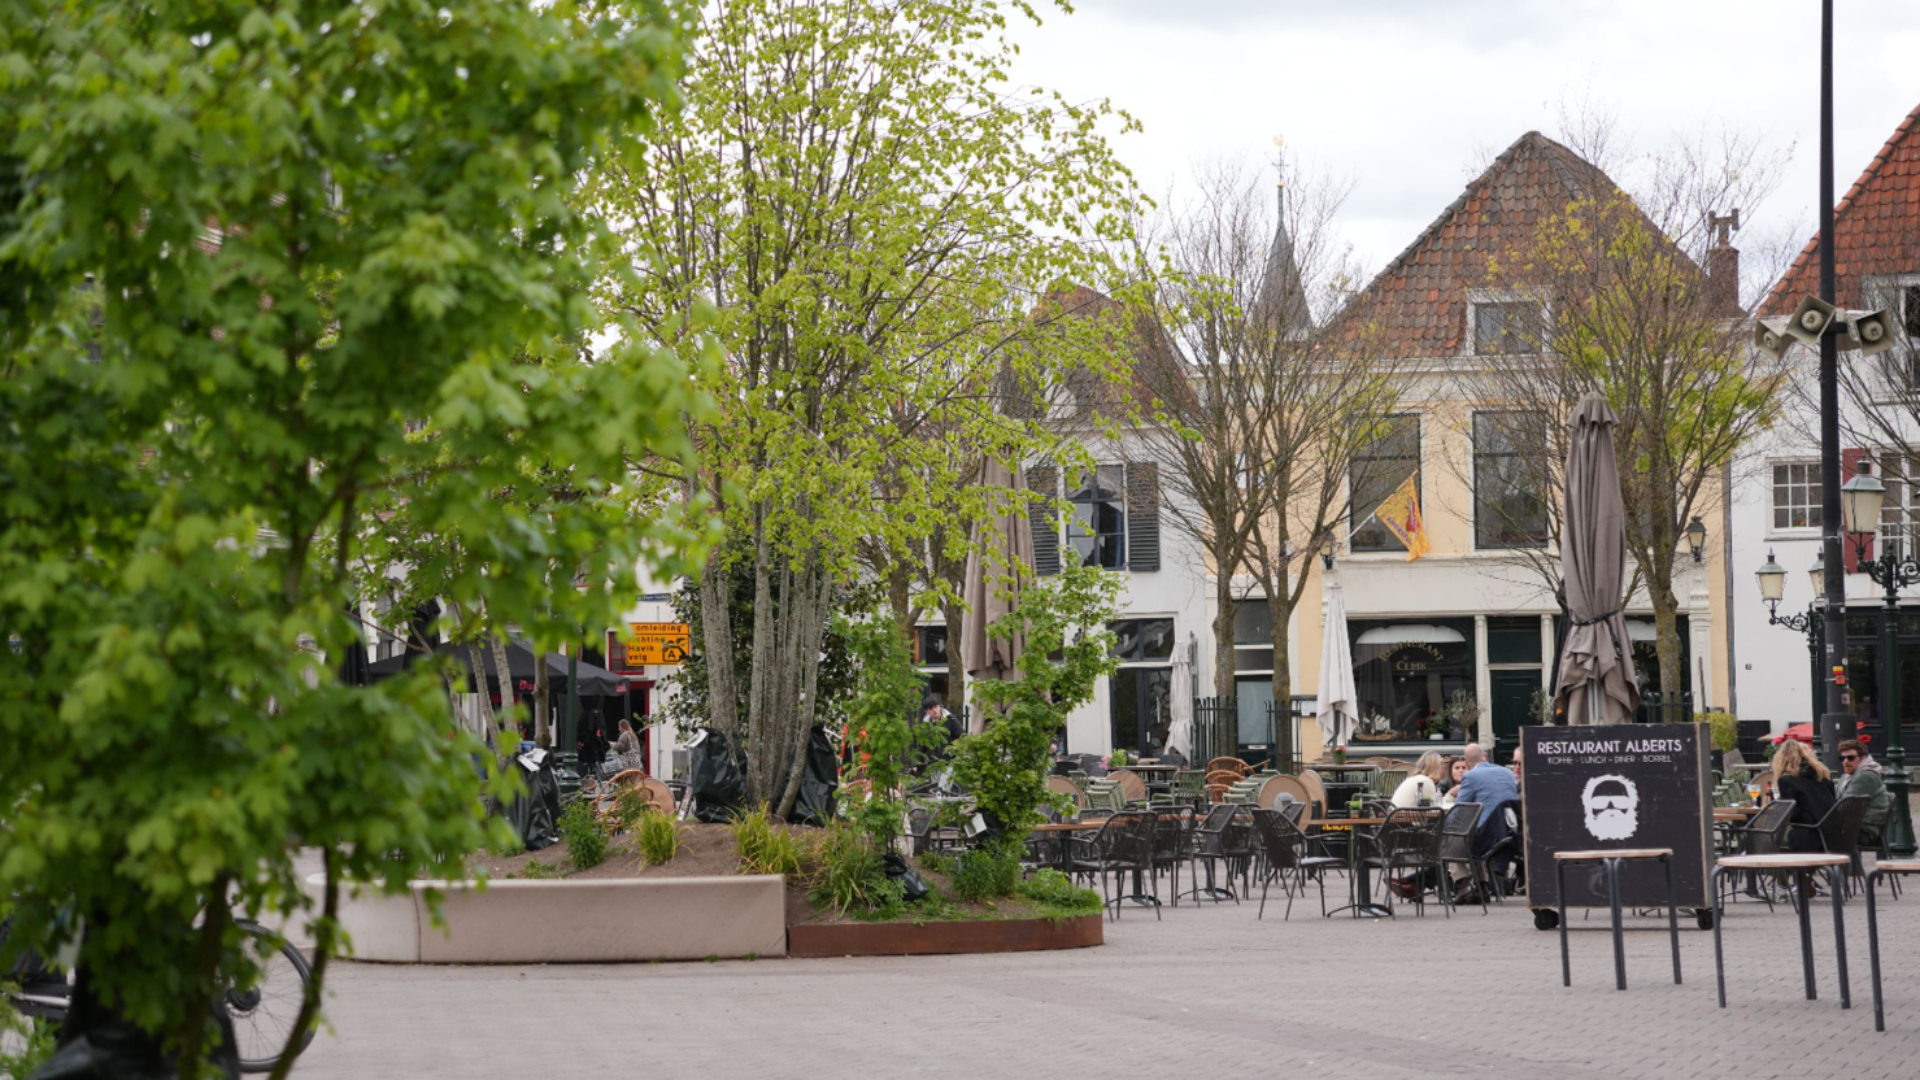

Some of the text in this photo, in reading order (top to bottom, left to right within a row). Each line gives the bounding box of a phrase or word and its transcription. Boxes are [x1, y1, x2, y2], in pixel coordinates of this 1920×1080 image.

[668, 650, 675, 658] A
[1537, 740, 1682, 754] RESTAURANT ALBERTS
[1581, 755, 1606, 764] LUNCH
[1614, 755, 1635, 764] DINER
[1642, 754, 1672, 763] BORREL
